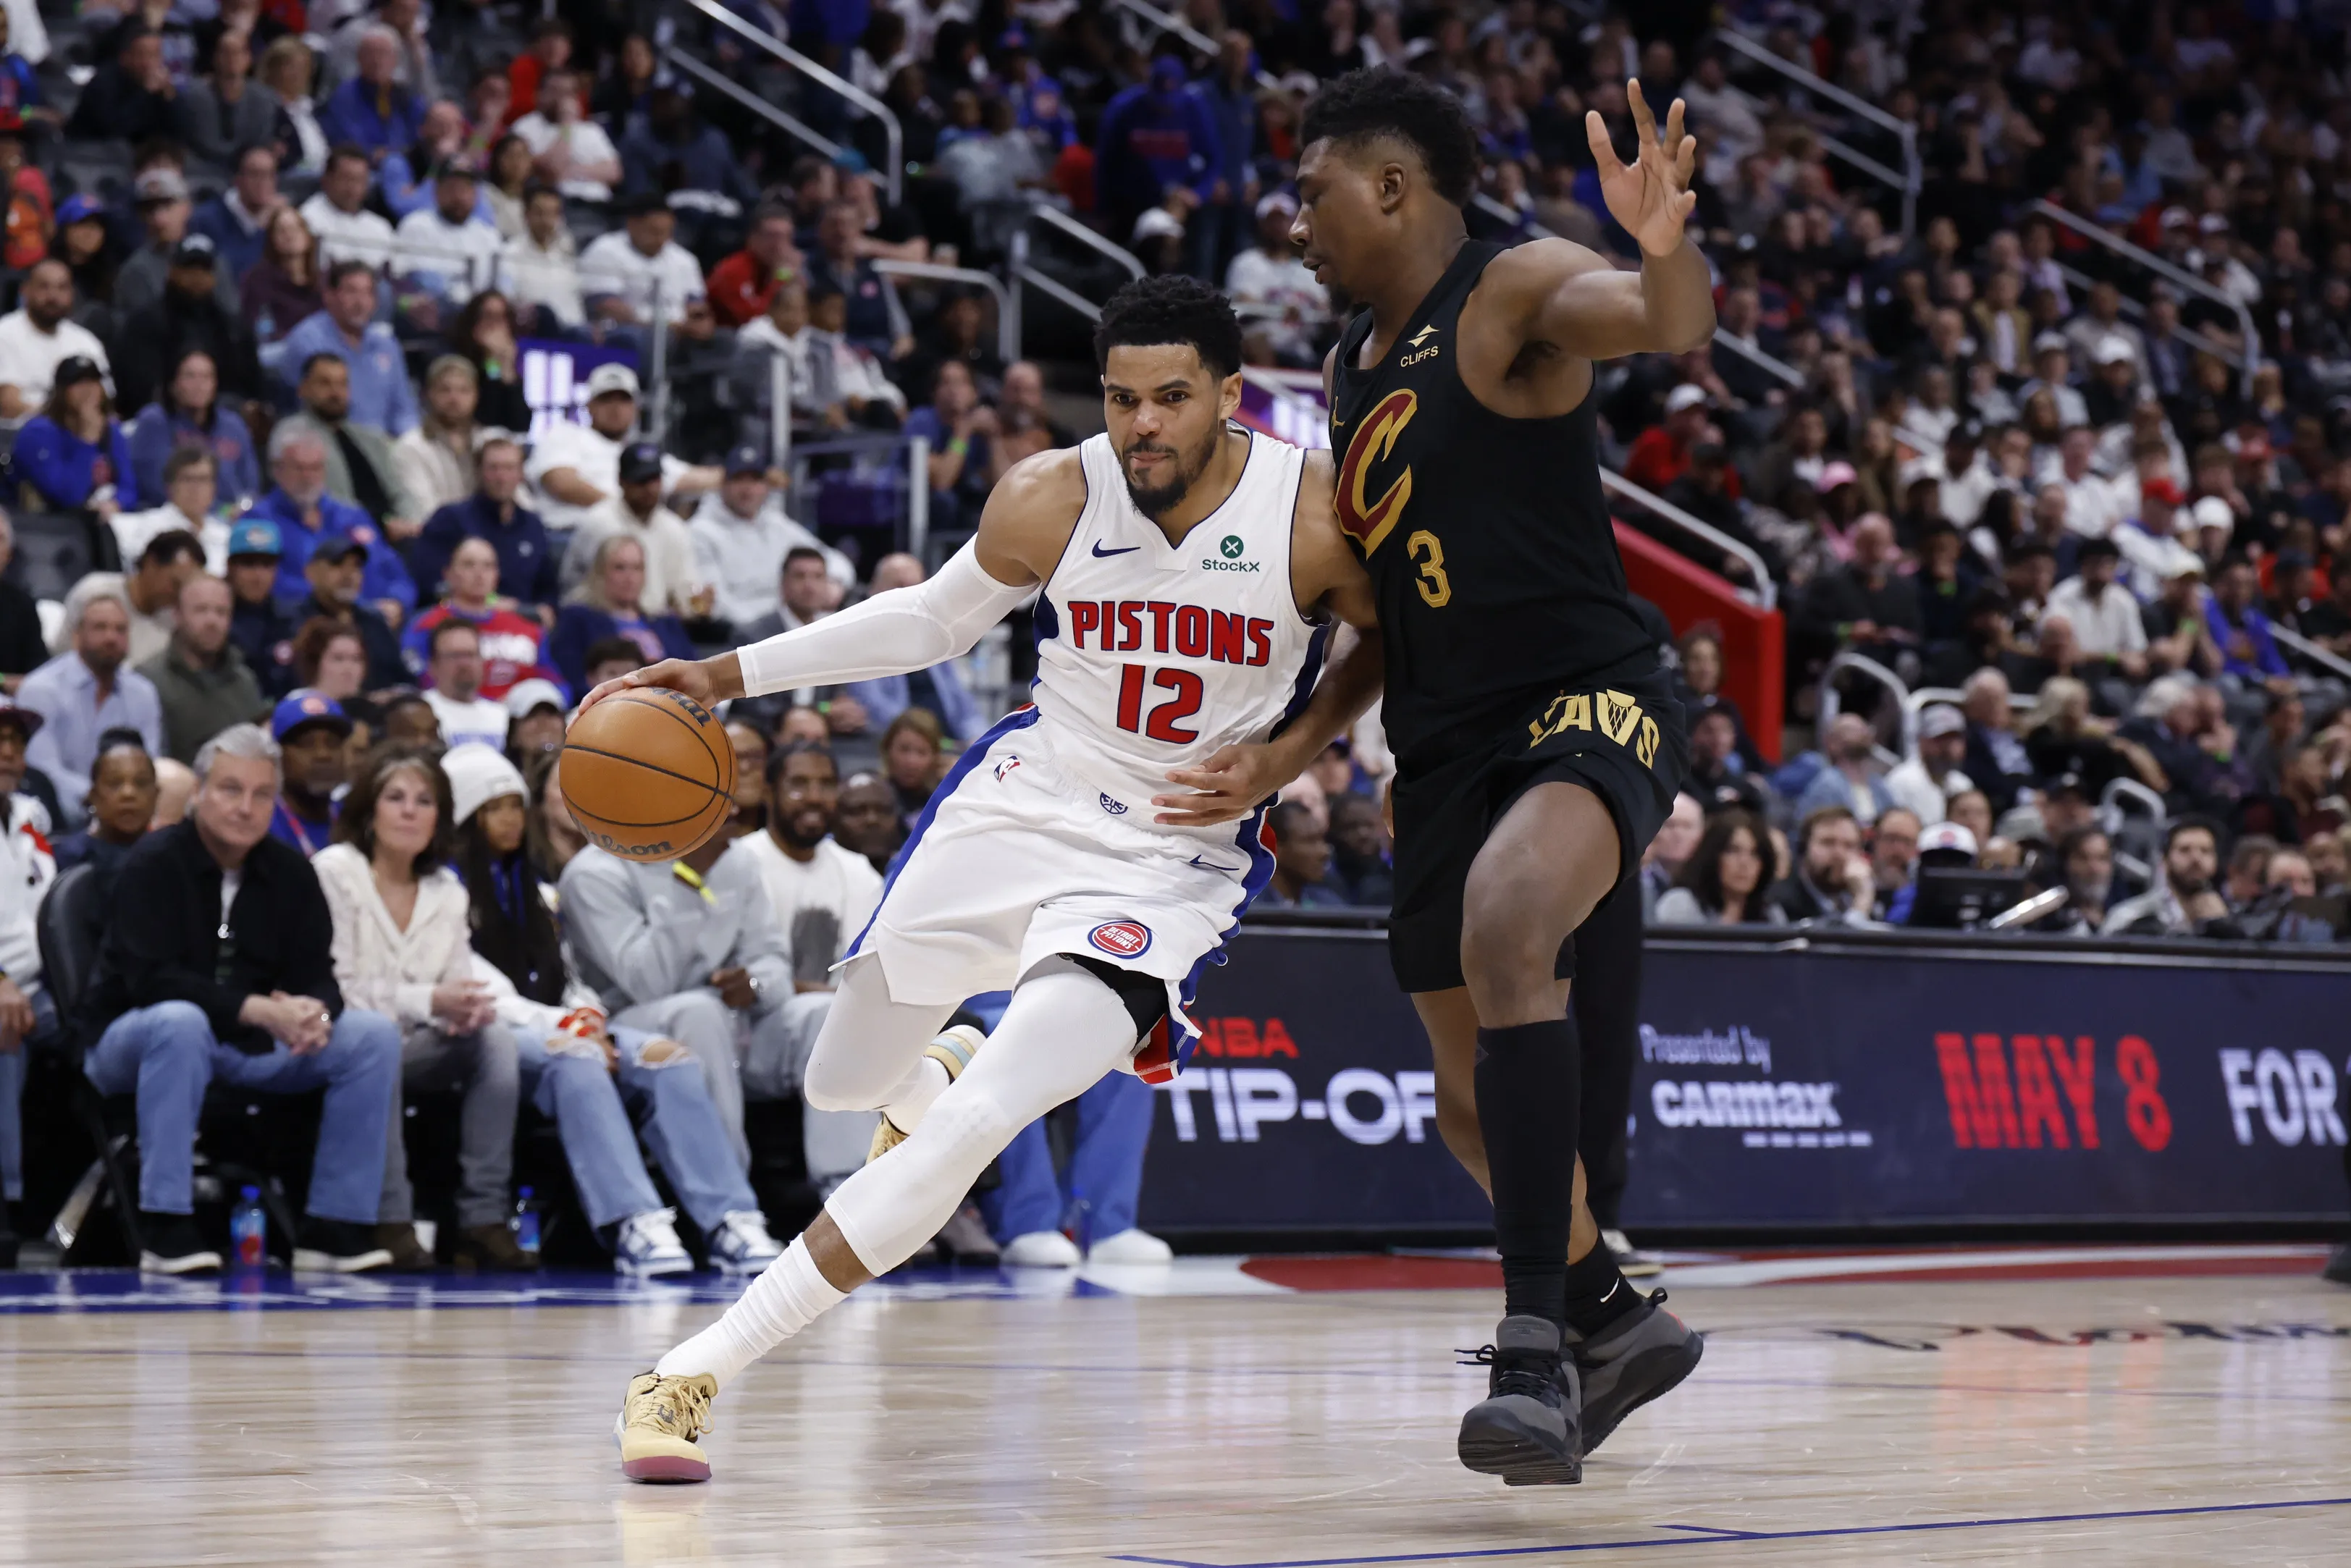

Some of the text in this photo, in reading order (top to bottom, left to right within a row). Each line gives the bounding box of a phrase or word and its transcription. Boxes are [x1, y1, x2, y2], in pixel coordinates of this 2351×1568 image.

[1400, 345, 1439, 368] CLIFFS
[1201, 559, 1260, 573] StockX
[1406, 529, 1452, 608] 3
[1067, 600, 1274, 667] PISTONS
[1116, 663, 1204, 744] 12
[1100, 930, 1135, 949] PISTONS
[1107, 926, 1140, 944] DETROIT
[1193, 1016, 1300, 1059] NBA
[1739, 1024, 1772, 1074] by
[1156, 1066, 1437, 1145] TIP-OF
[1933, 1030, 2173, 1153] MAY 8
[2218, 1046, 2349, 1147] FOR
